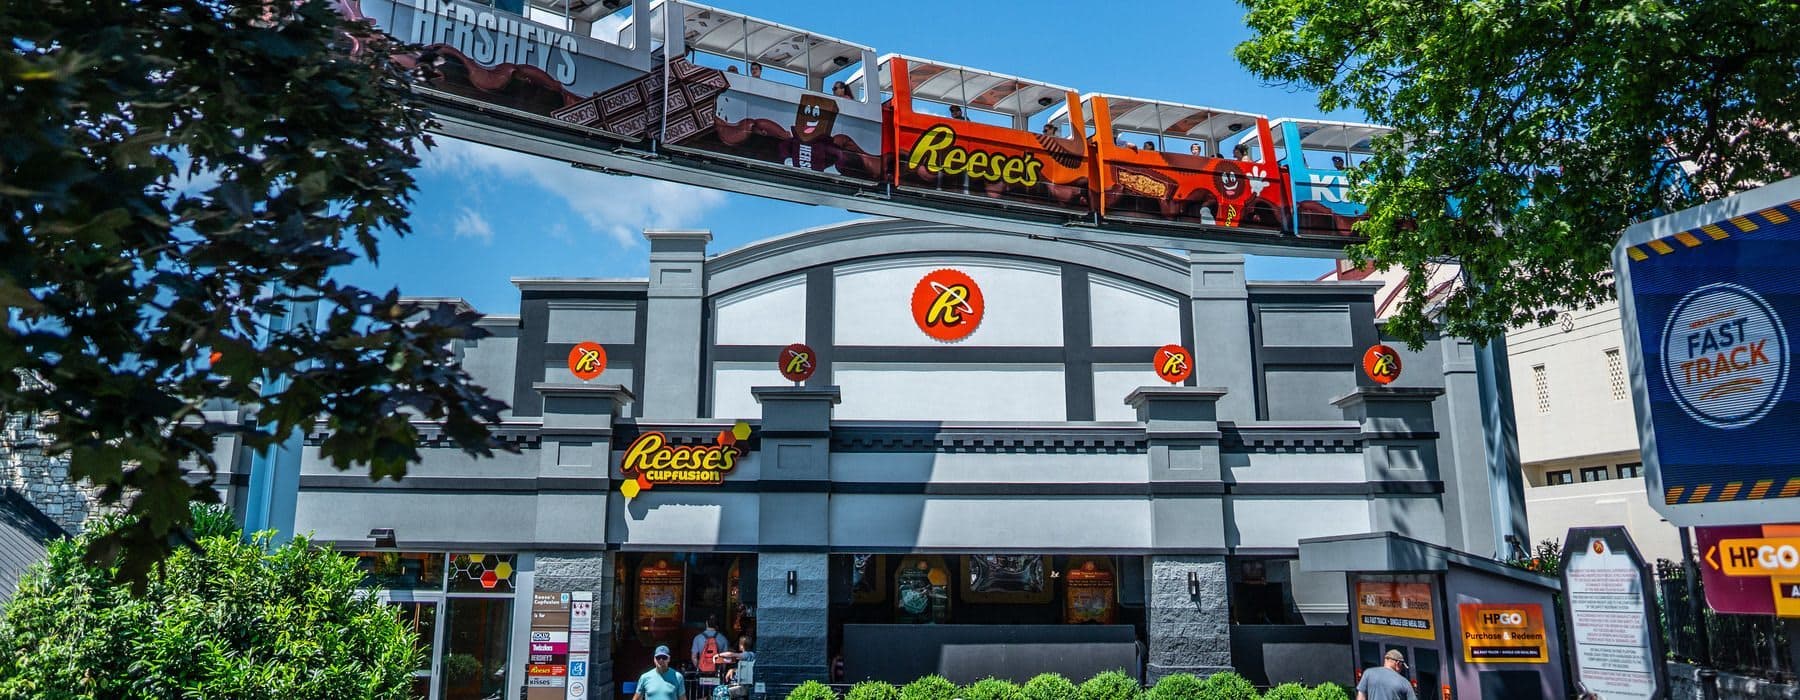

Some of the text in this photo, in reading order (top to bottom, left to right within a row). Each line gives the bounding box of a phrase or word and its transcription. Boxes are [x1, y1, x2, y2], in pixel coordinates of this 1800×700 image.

[411, 0, 577, 86] HERSHEY'S
[907, 125, 1042, 187] Reese's
[1687, 317, 1748, 359] FAST
[1681, 339, 1769, 385] TRACK
[624, 434, 738, 470] Reese's
[1728, 545, 1799, 569] HPGO
[1465, 631, 1501, 640] Purchase
[1511, 631, 1542, 640] Redeem
[1484, 613, 1522, 625] HPGO
